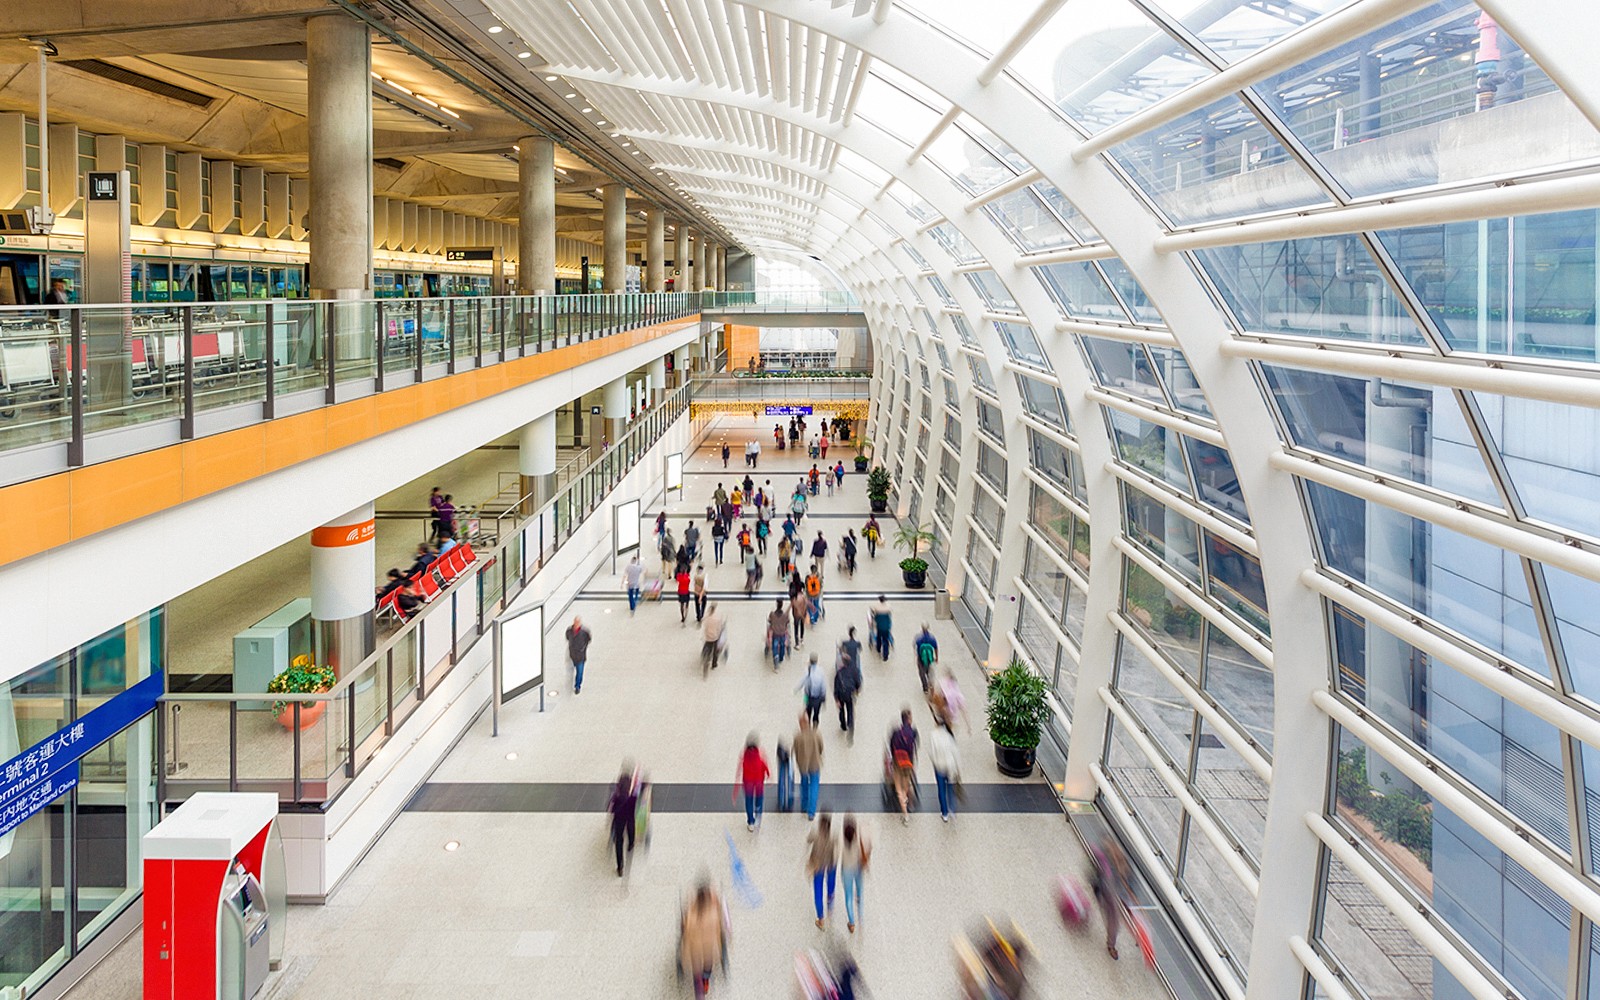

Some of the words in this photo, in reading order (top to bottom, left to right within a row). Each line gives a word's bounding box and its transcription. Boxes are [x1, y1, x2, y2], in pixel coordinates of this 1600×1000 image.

[41, 762, 49, 776] 2
[0, 779, 52, 825] 內地交通
[21, 810, 28, 819] to
[29, 791, 58, 815] Mainland
[58, 778, 76, 791] China
